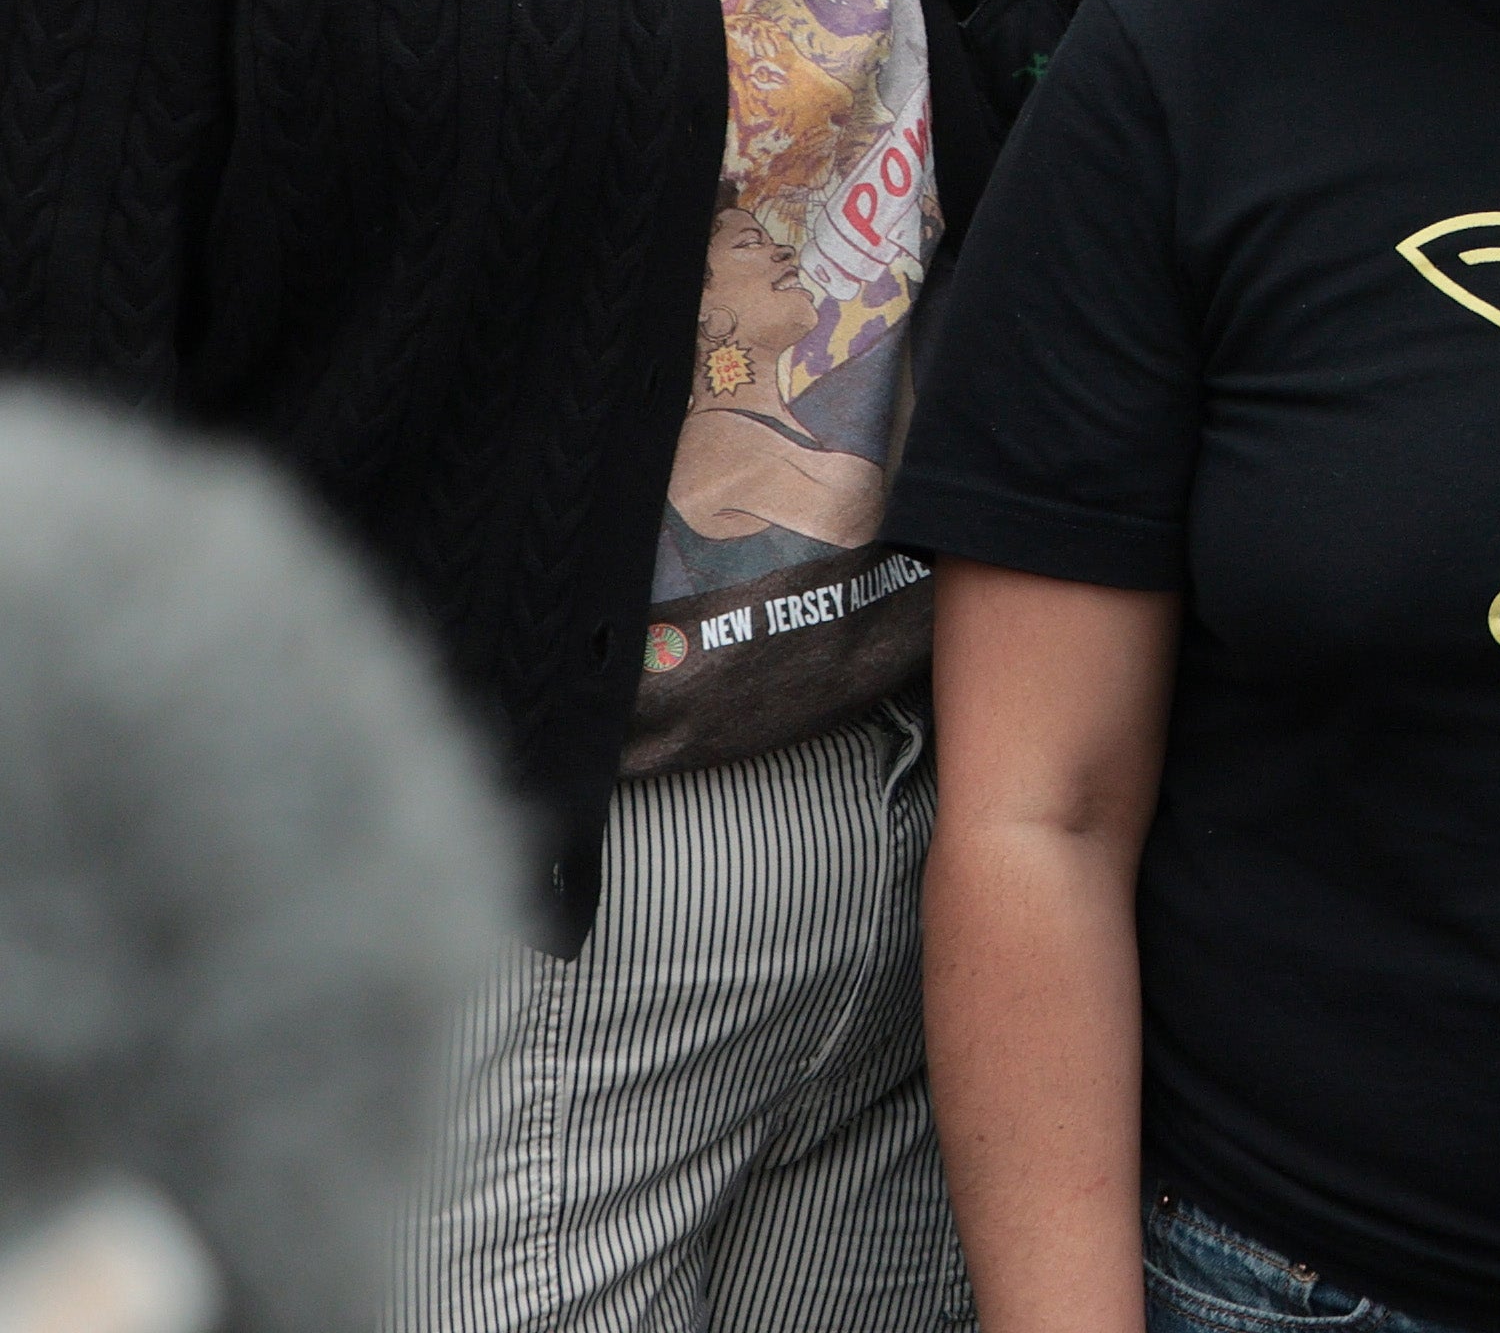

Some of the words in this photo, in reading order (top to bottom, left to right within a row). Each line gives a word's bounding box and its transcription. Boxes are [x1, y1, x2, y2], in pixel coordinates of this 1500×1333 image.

[700, 605, 753, 652] NEW
[764, 582, 845, 636] JERSEY
[850, 553, 932, 613] ALLIANCE
